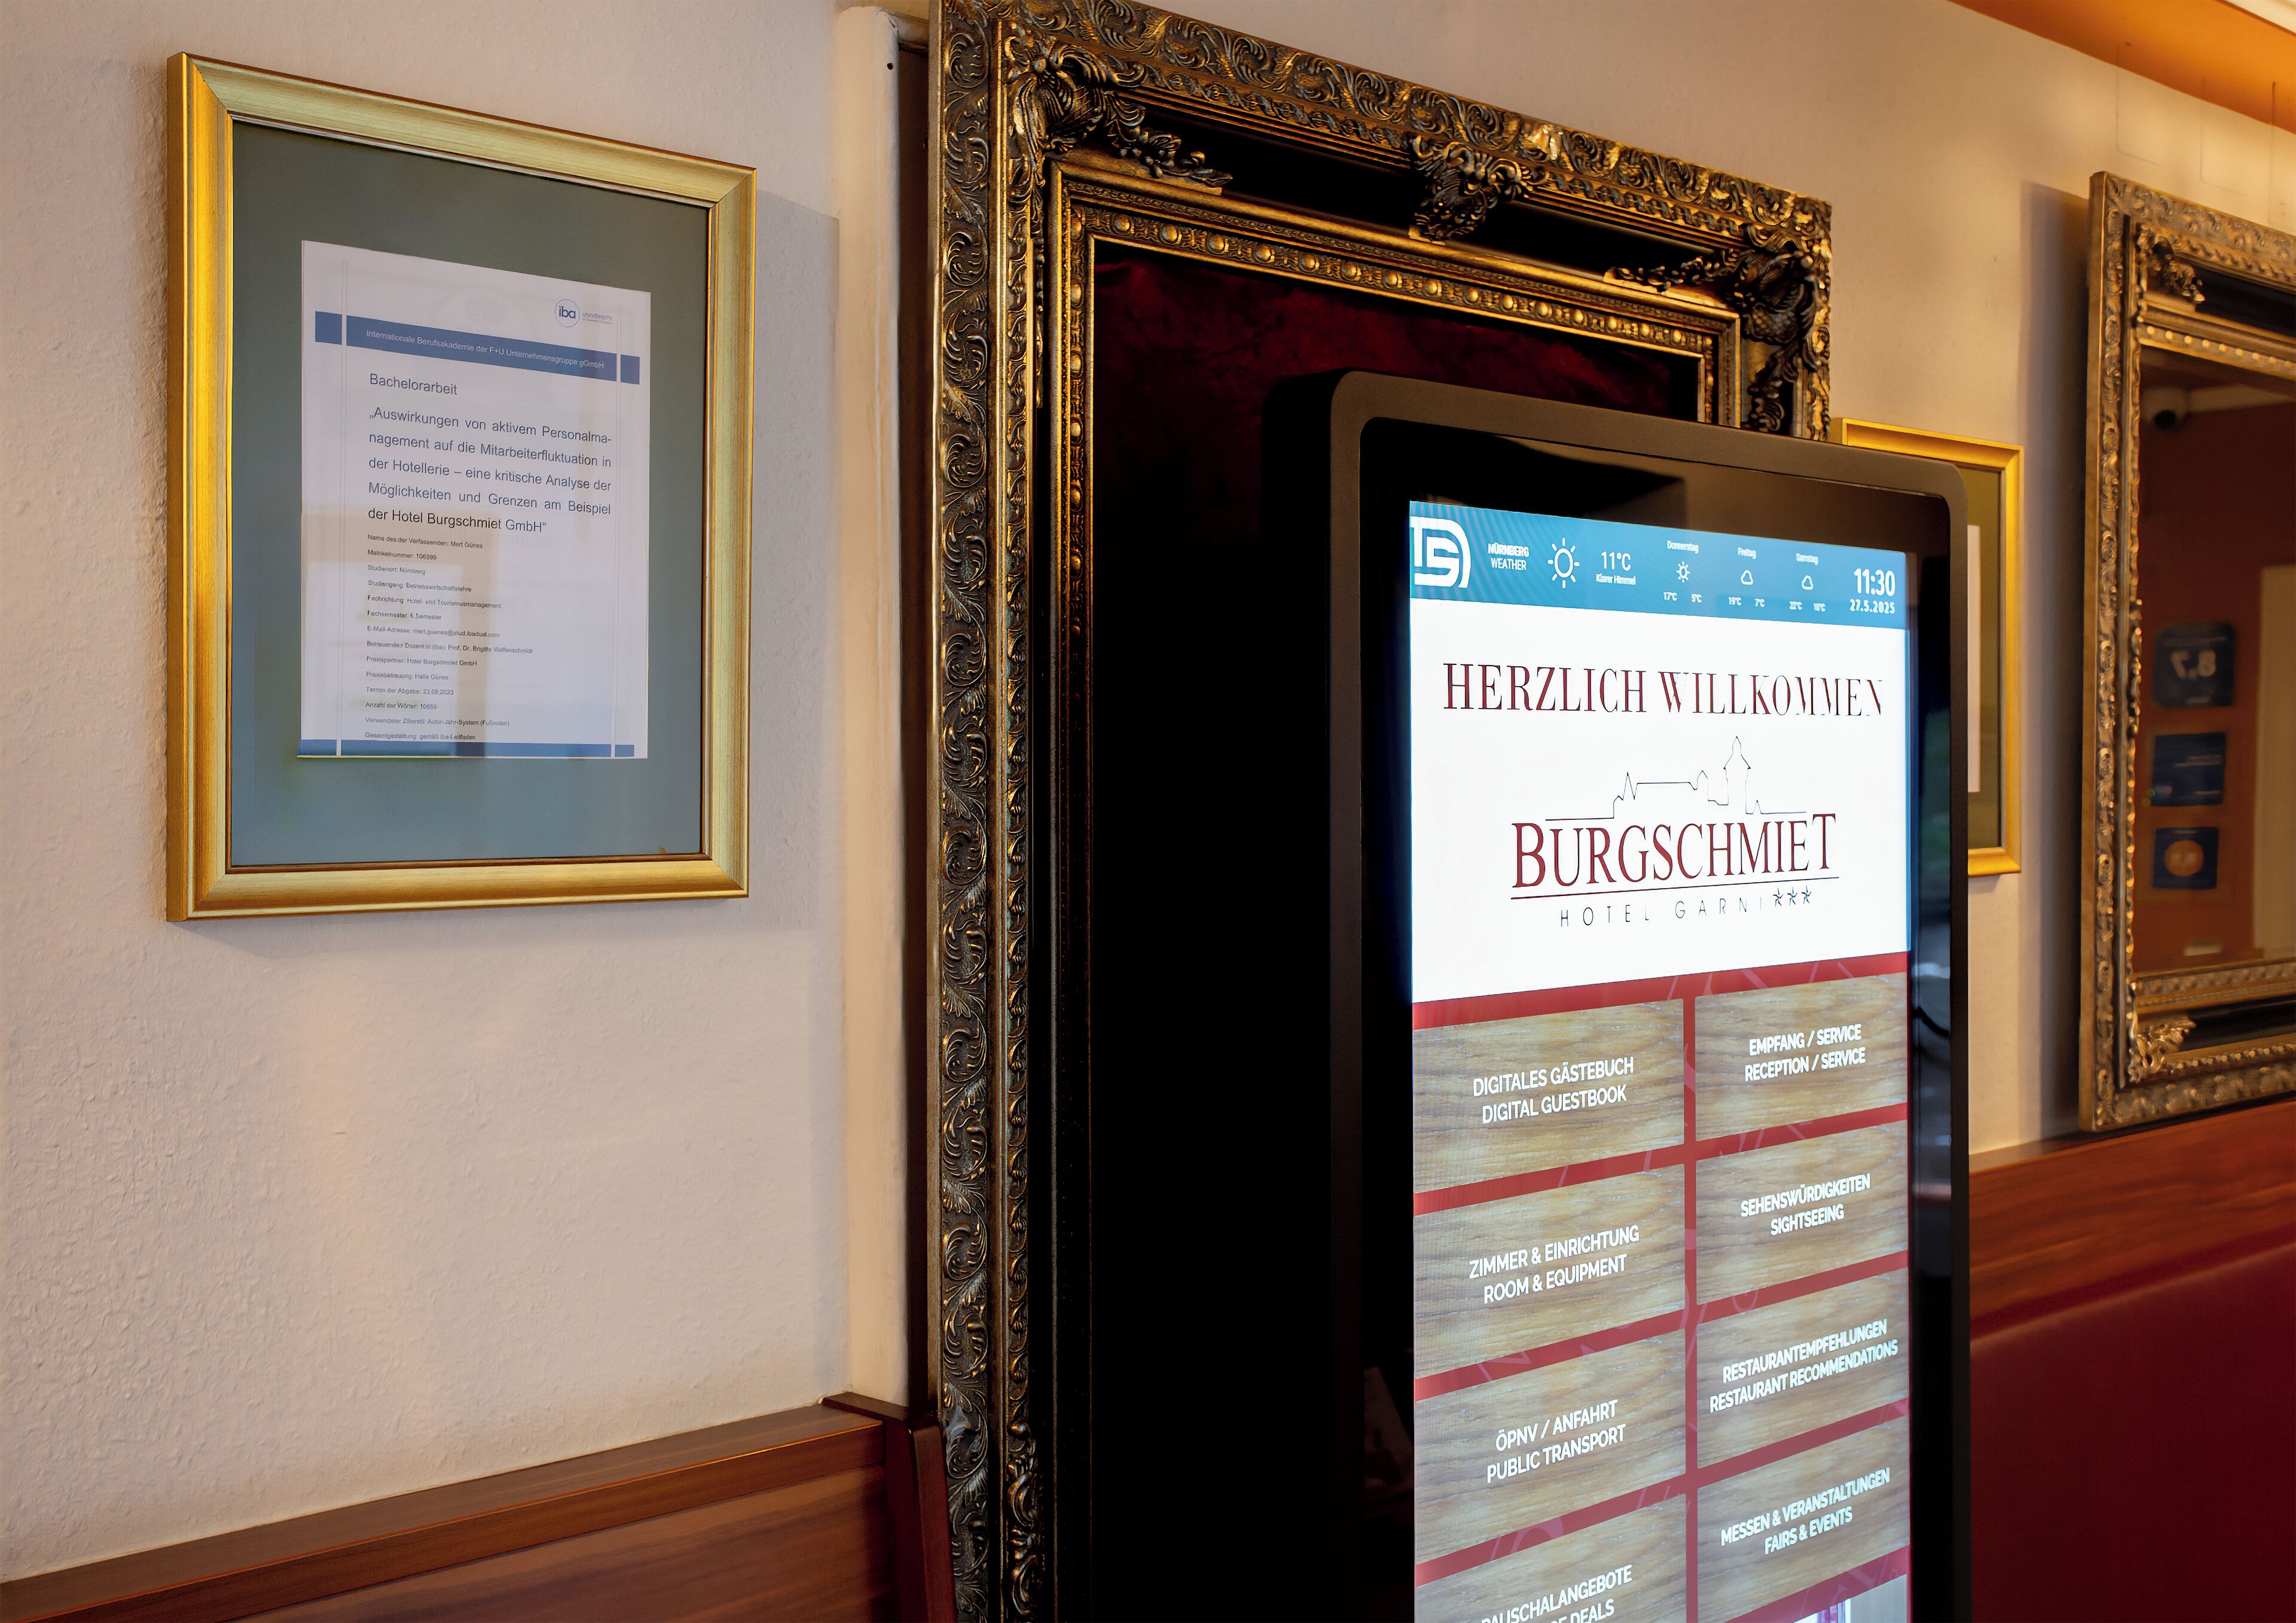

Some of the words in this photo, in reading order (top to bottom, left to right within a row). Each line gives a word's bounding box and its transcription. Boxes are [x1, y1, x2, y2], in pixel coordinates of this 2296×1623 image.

[559, 306, 576, 319] iba
[367, 330, 415, 343] Internationale
[417, 337, 475, 350] Berufsakademie
[490, 347, 504, 355] F+U
[506, 349, 578, 365] Unternehmensgruppe
[579, 359, 604, 370] gGmbH
[370, 373, 457, 395] Bachelorarbeit
[370, 407, 458, 428] „Auswirkungen
[465, 420, 486, 430] von
[493, 421, 536, 435] aktivem
[542, 426, 611, 443] Personalma-
[370, 434, 429, 449] nagement
[435, 440, 453, 451] auf
[457, 441, 475, 453] die
[481, 443, 597, 466] Mitarbeiterfluktuation
[603, 456, 610, 467] in
[369, 457, 389, 469] der
[393, 459, 449, 475] Hotellerie
[466, 467, 491, 479] eine
[496, 469, 542, 484] kritische
[545, 475, 590, 490] Analyse
[594, 480, 611, 491] der
[370, 482, 450, 501] Möglichkeiten
[459, 492, 480, 502] und
[488, 493, 537, 508] Grenzen
[545, 501, 561, 510] am
[569, 501, 610, 515] Beispiel
[368, 508, 388, 520] der
[392, 510, 423, 523] Hotel
[428, 512, 502, 529] Burgschmiet
[409, 538, 448, 546] Verfassenden:
[1488, 542, 1529, 557] NÜRNBERG
[400, 567, 426, 576] Nürnberg
[1491, 557, 1527, 571] WEATHER
[1601, 551, 1631, 571] 11°C
[406, 582, 472, 593] Betriebswirtschaftslehre
[1854, 568, 1895, 597] 11:30
[438, 599, 502, 610] Tourismusmanagement
[1849, 599, 1895, 614] 27.5.2025
[1443, 663, 1647, 713] HERZLICH
[1658, 671, 1883, 716] WILLKOMMEN
[428, 718, 479, 728] Autor-Jahr-System
[439, 733, 476, 742] iba-Leitfaden
[1512, 813, 1836, 888] BURGSCHMIET
[1561, 904, 1649, 928] HOTEL
[1750, 1033, 1805, 1055] EMPFANG
[1817, 1024, 1861, 1045] SERVICE
[1474, 1069, 1547, 1096] DIGITALES
[1550, 1057, 1633, 1084] GÄSTEBUCH
[1745, 1056, 1809, 1081] RECEPTION
[1821, 1047, 1866, 1069] SERVICE
[1483, 1099, 1538, 1124] DIGITAL
[1541, 1084, 1626, 1113] GUESTBOOK
[1741, 1173, 1870, 1216] SEHENSWÜRDIGKEITEN
[1771, 1204, 1844, 1235] SIGHTSEEING
[1470, 1250, 1528, 1279] ZIMMER
[1531, 1247, 1541, 1264] &
[1545, 1225, 1639, 1261] EINRICHTUNG
[1485, 1277, 1528, 1304] ROOM
[1532, 1274, 1543, 1292] &
[1547, 1254, 1627, 1289] EQUIPMENT
[1723, 1319, 1886, 1383] RESTAURANTEMPFEHLUNGEN
[1711, 1373, 1788, 1413] RESTAURANT
[1790, 1340, 1898, 1387] RECOMMENDATIONS
[1496, 1423, 1538, 1451] ÖPNV
[1553, 1399, 1617, 1435] ANFAHRT
[1488, 1451, 1540, 1483] PUBLIC
[1543, 1424, 1626, 1465] TRANSPORT
[1721, 1513, 1770, 1546] MESSEN
[1782, 1468, 1889, 1521] VERANSTALTUNGEN
[1765, 1528, 1797, 1554] FAIRS
[1810, 1506, 1852, 1536] EVENTS
[1481, 1564, 1633, 1623] USCHALANGEBOTE
